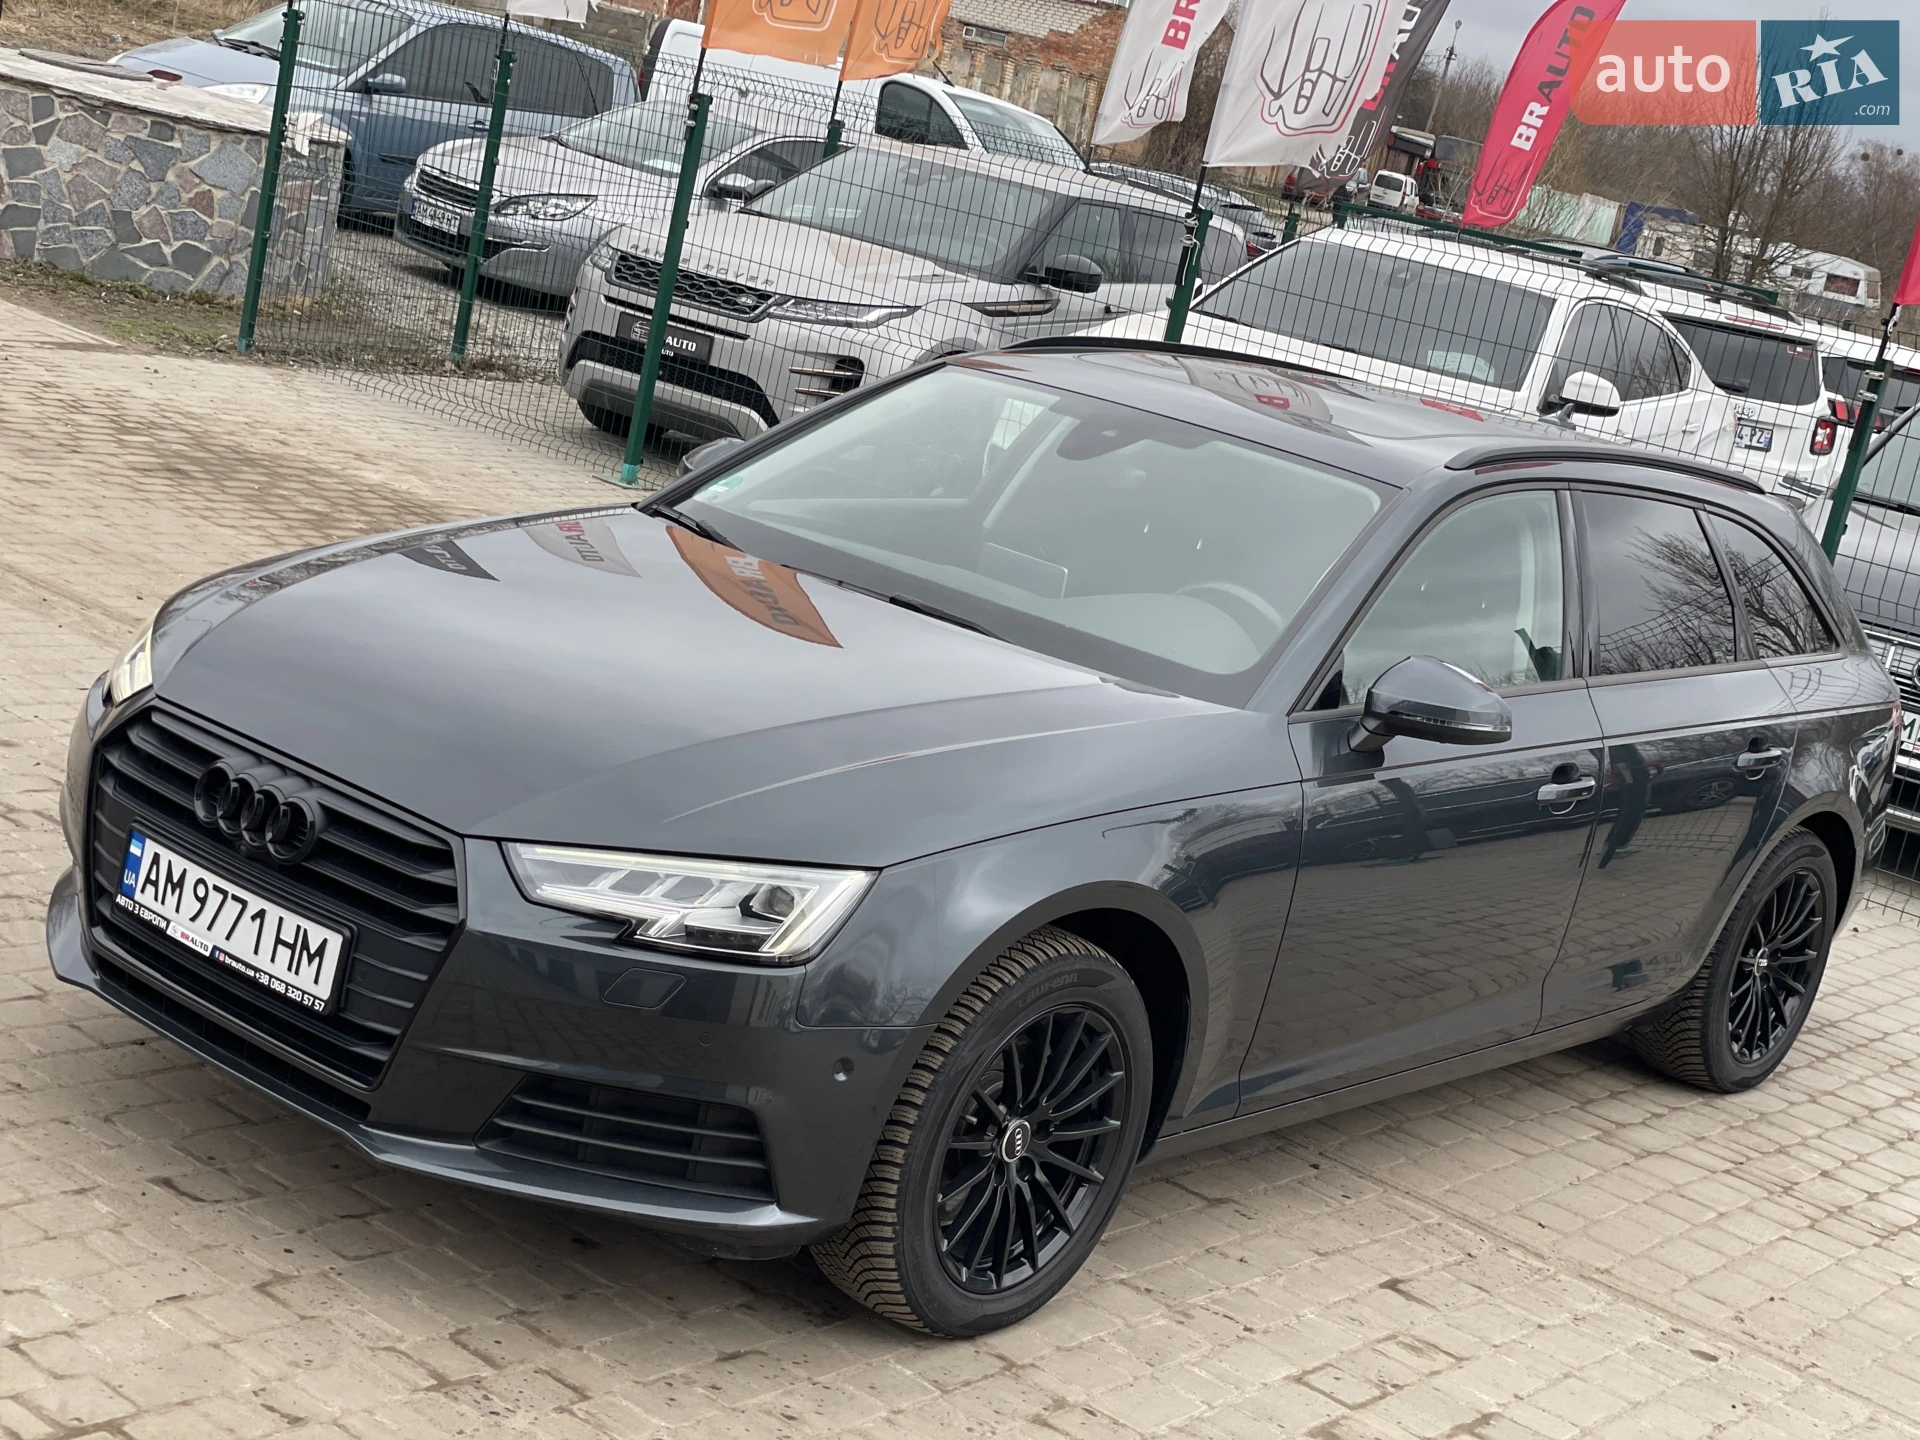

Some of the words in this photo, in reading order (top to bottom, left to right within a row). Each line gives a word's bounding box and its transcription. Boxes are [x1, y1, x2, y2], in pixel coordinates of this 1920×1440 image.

[1510, 5, 1595, 152] BRAUTO
[630, 243, 690, 265] RANE
[703, 263, 774, 287] ROVER
[665, 335, 697, 352] AUTO
[1734, 403, 1756, 418] Jeep
[1737, 425, 1765, 445] 4-PZ
[124, 869, 136, 888] UA
[180, 931, 209, 952] BRAUTO
[225, 955, 255, 978] brauto.ua
[255, 971, 270, 986] +38
[270, 978, 287, 994] 068
[286, 985, 302, 1001] 320
[303, 994, 314, 1007] 57
[313, 1000, 325, 1012] 57
